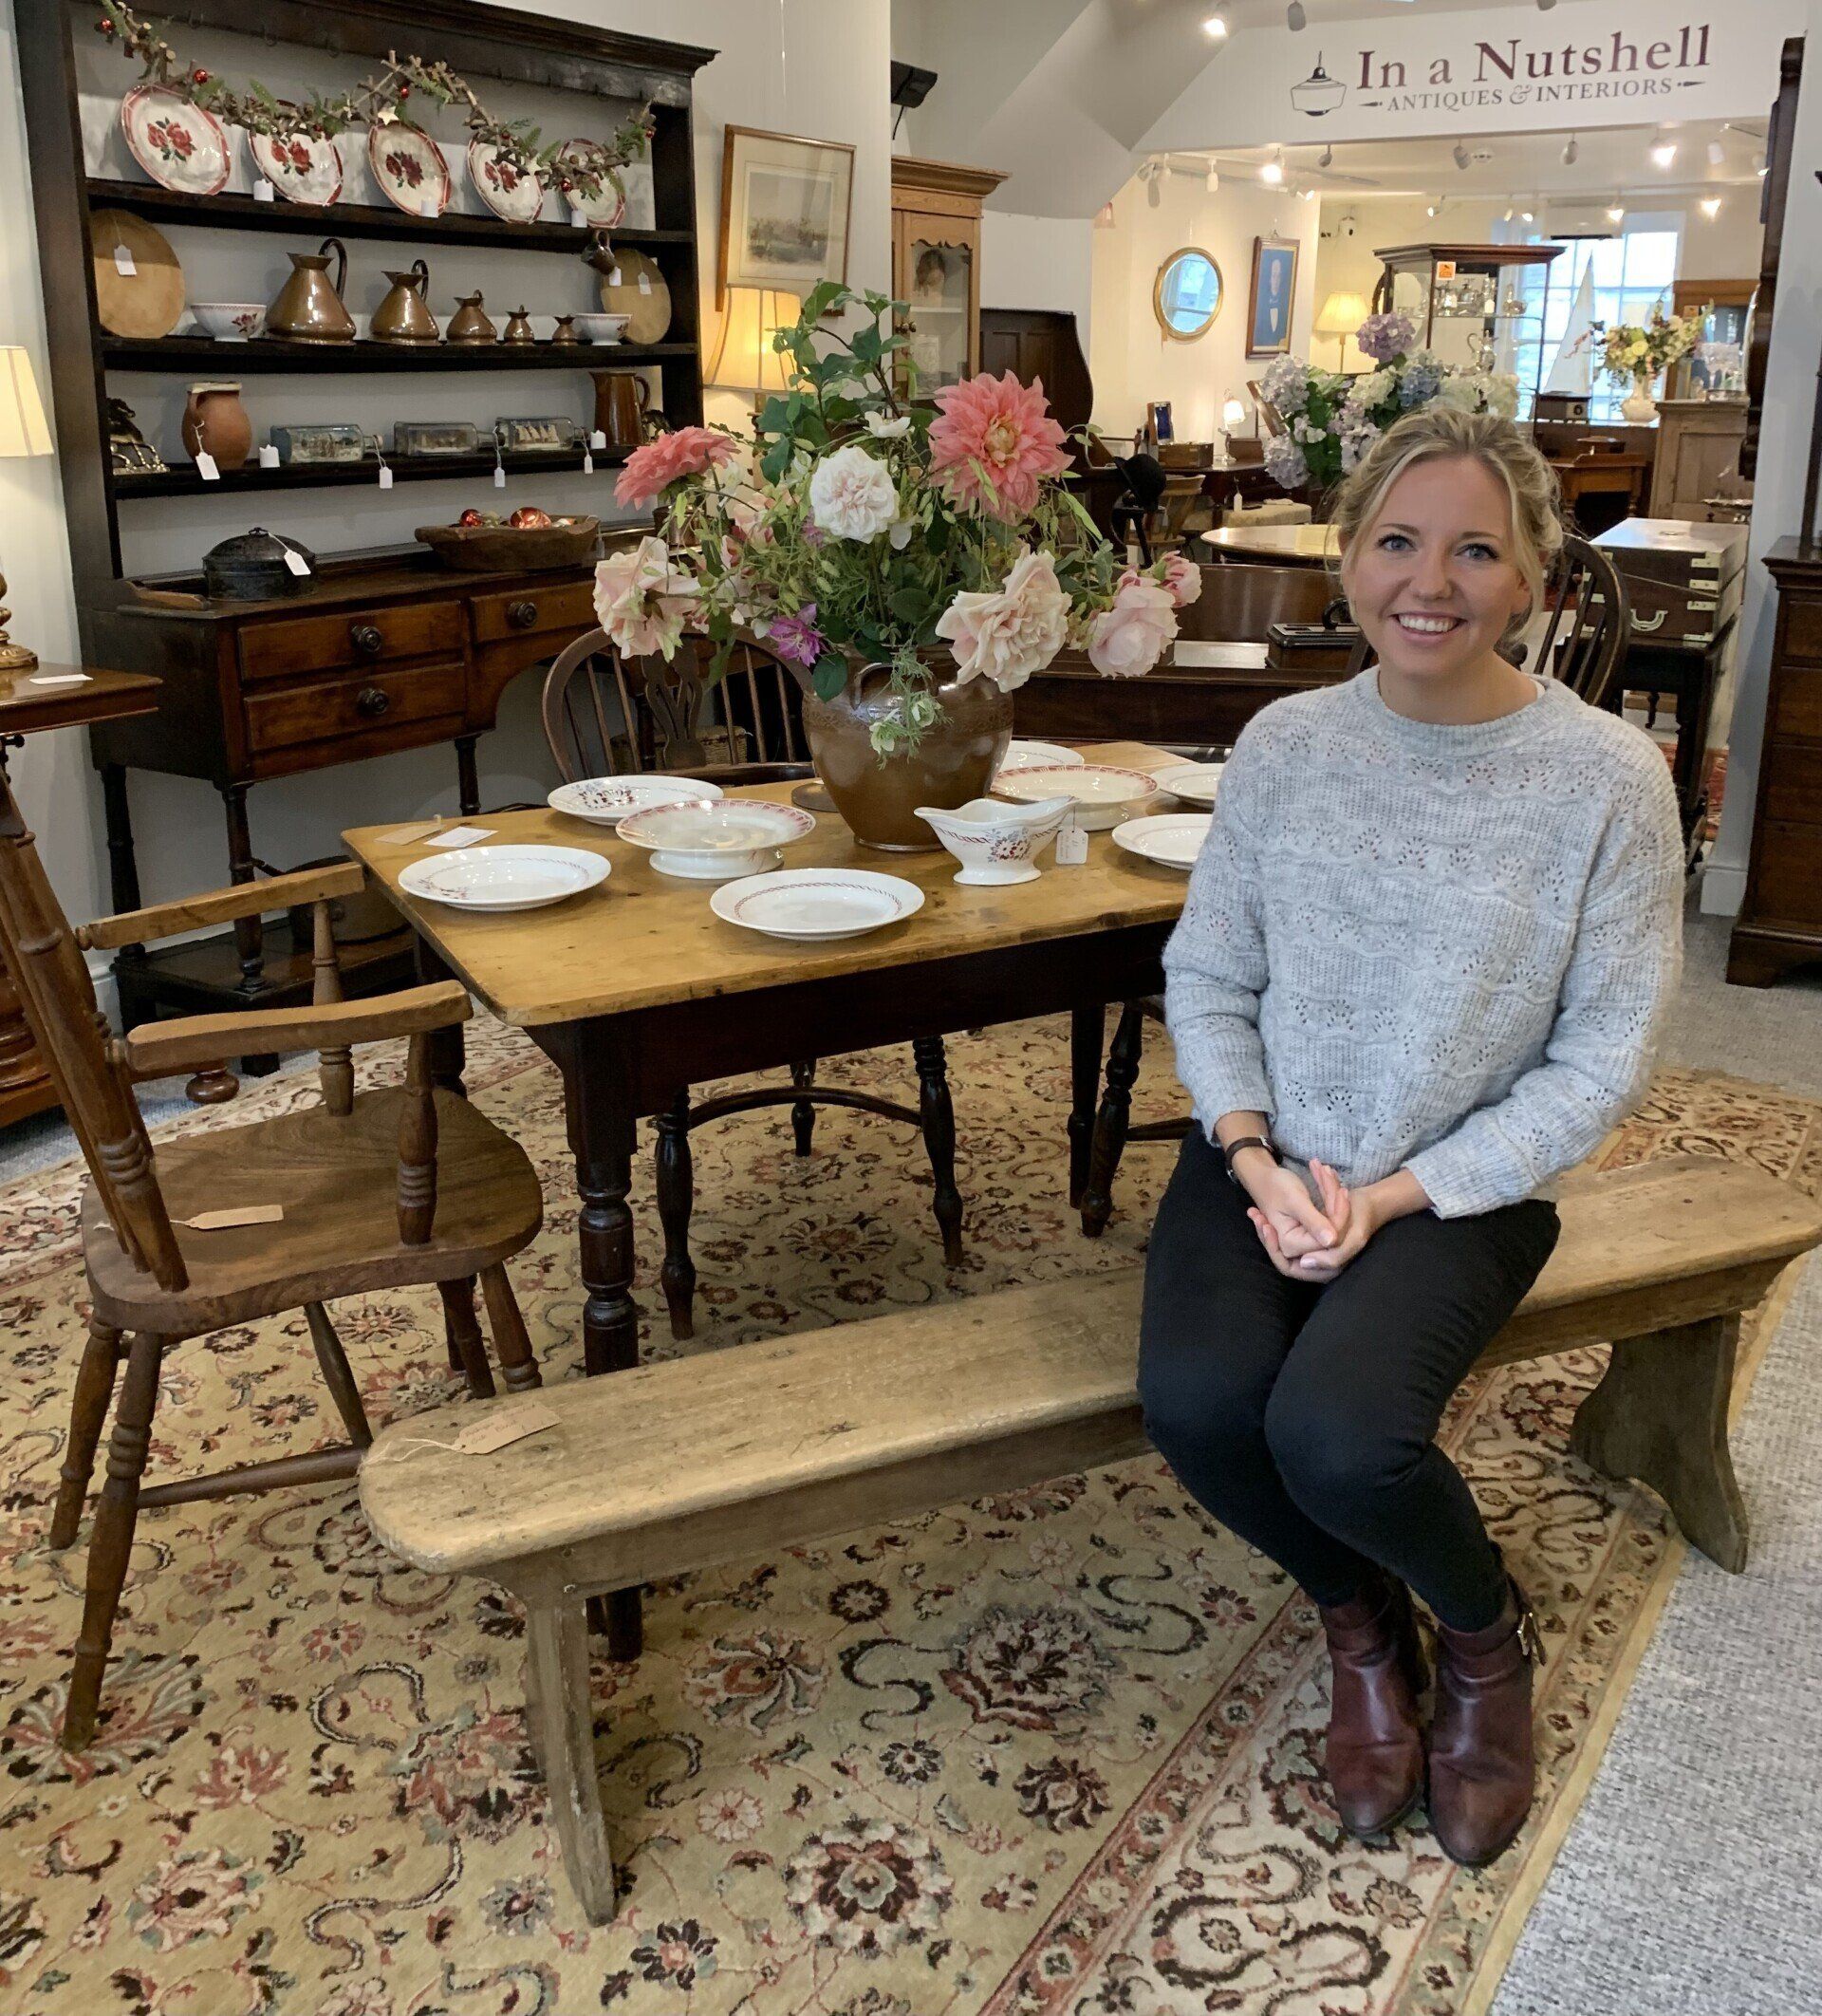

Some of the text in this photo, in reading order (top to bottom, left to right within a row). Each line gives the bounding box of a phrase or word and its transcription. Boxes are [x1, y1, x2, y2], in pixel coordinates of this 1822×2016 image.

[1356, 24, 1711, 90] In a Nutshell
[1386, 88, 1503, 112] ANTIQUES
[1535, 77, 1673, 102] INTERIORS
